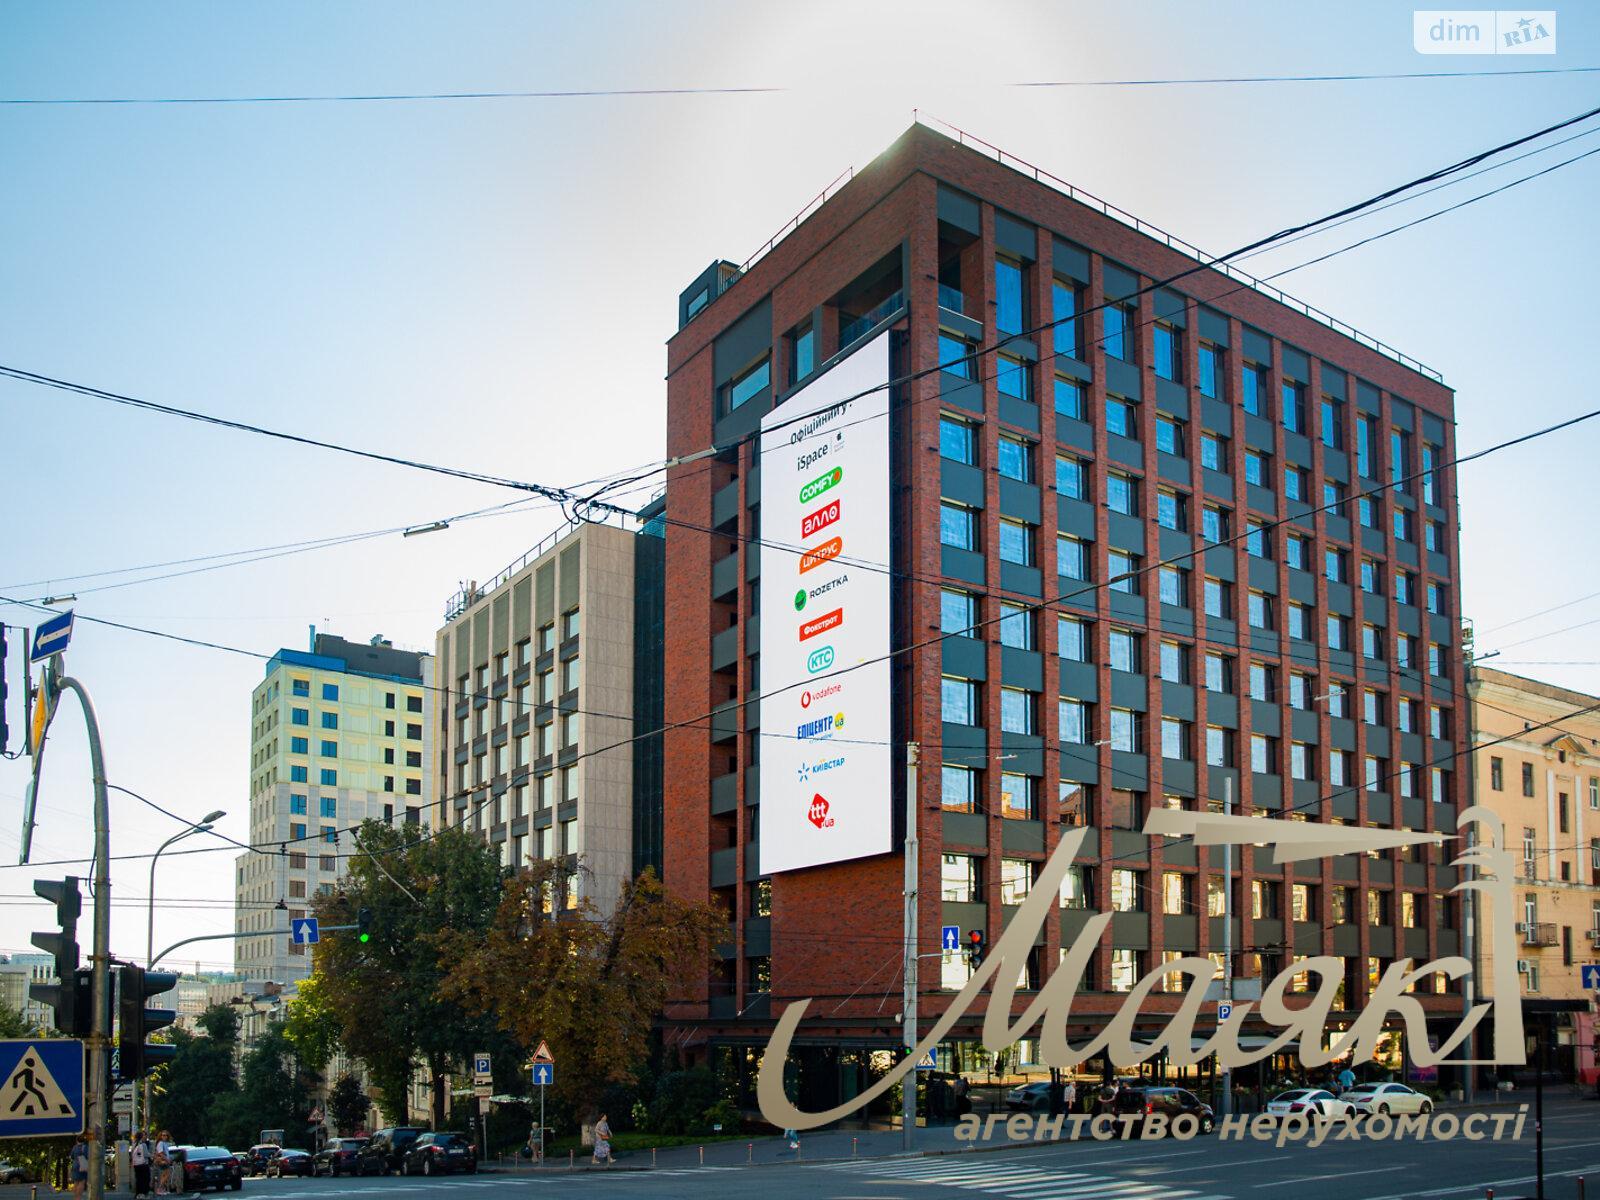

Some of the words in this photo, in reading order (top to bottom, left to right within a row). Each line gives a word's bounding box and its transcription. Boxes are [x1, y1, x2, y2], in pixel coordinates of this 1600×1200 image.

[797, 442, 829, 471] iSpace
[801, 473, 834, 501] COMFY
[809, 574, 849, 600] ROZETKA
[803, 615, 838, 636] Фокстрот
[812, 683, 842, 701] vodafone
[797, 714, 834, 740] ЕПІЦЕНТР
